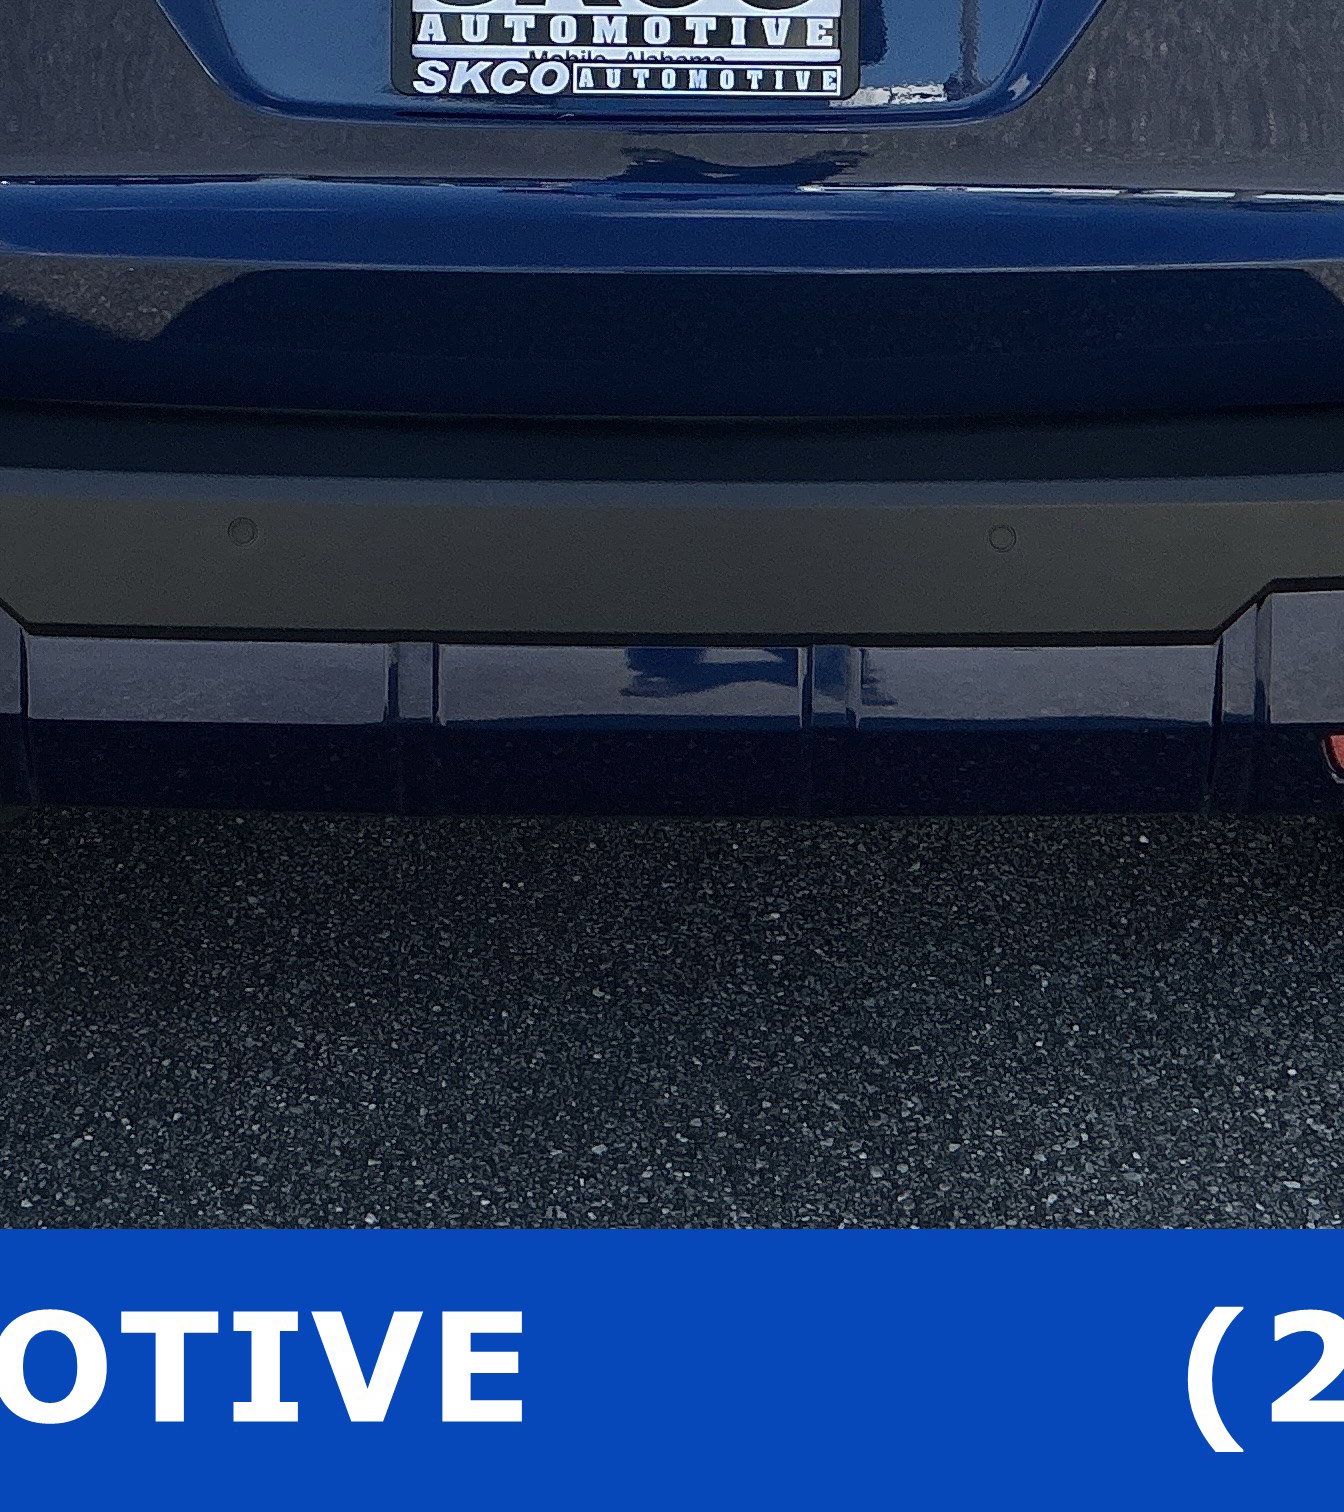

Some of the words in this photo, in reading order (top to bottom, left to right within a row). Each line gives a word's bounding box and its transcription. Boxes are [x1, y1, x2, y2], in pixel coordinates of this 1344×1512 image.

[417, 15, 833, 47] AUTOMOTIVE
[412, 60, 570, 95] SKCO
[578, 67, 838, 92] AUTOMOTIVE
